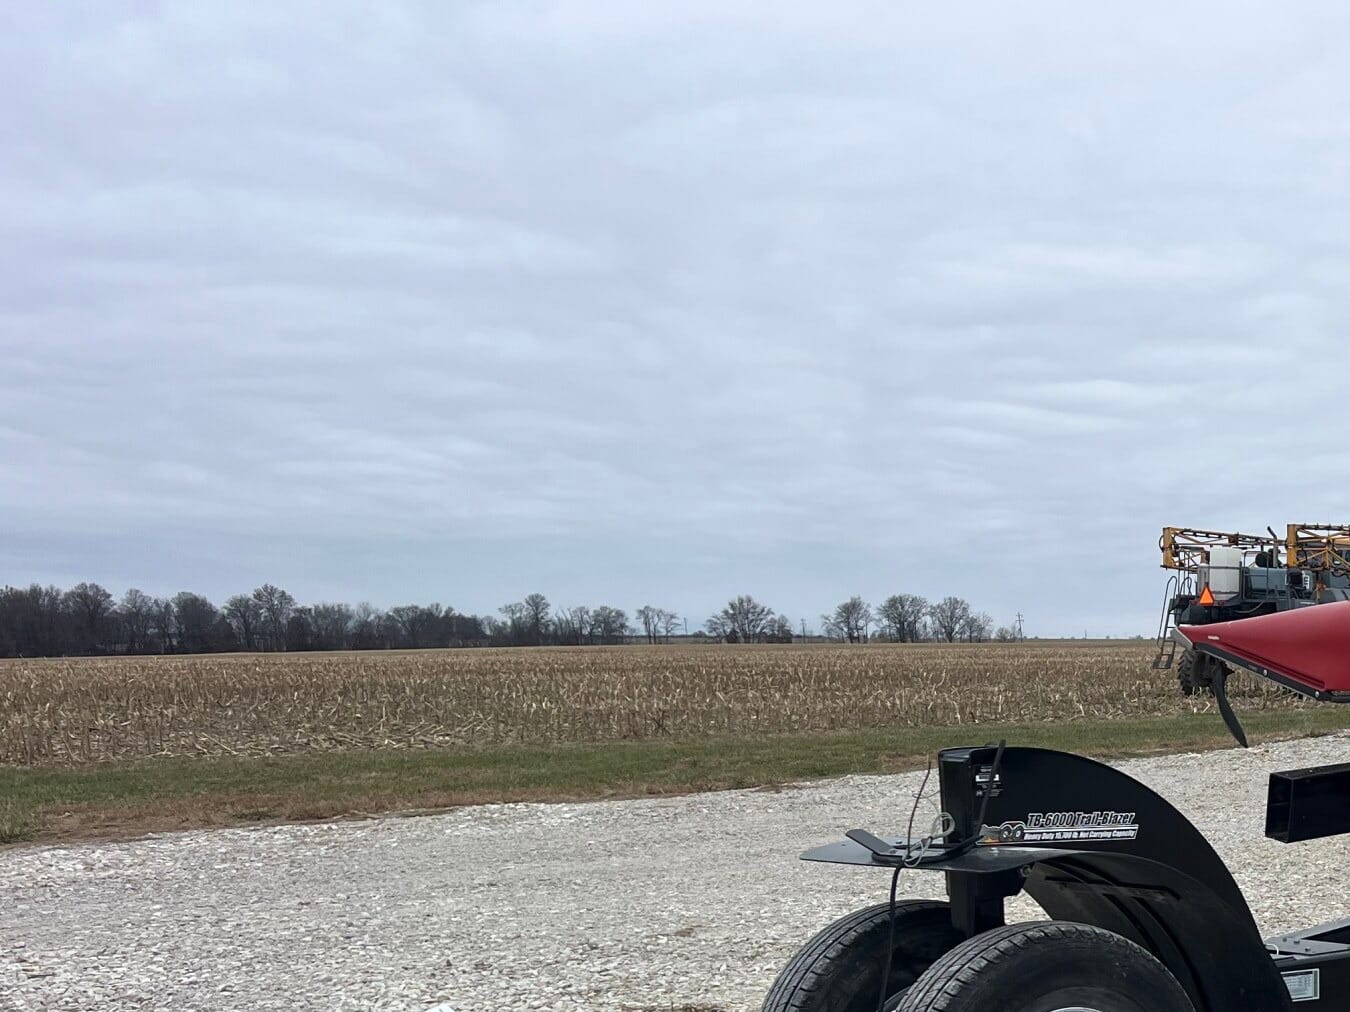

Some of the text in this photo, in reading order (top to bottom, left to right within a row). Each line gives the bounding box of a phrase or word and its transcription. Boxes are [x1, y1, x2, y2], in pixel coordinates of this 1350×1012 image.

[1027, 811, 1135, 826] TB-6000 Trail-Blazer
[1041, 832, 1055, 840] Duty
[1089, 830, 1112, 838] Carrying
[1112, 829, 1135, 838] Capacity
